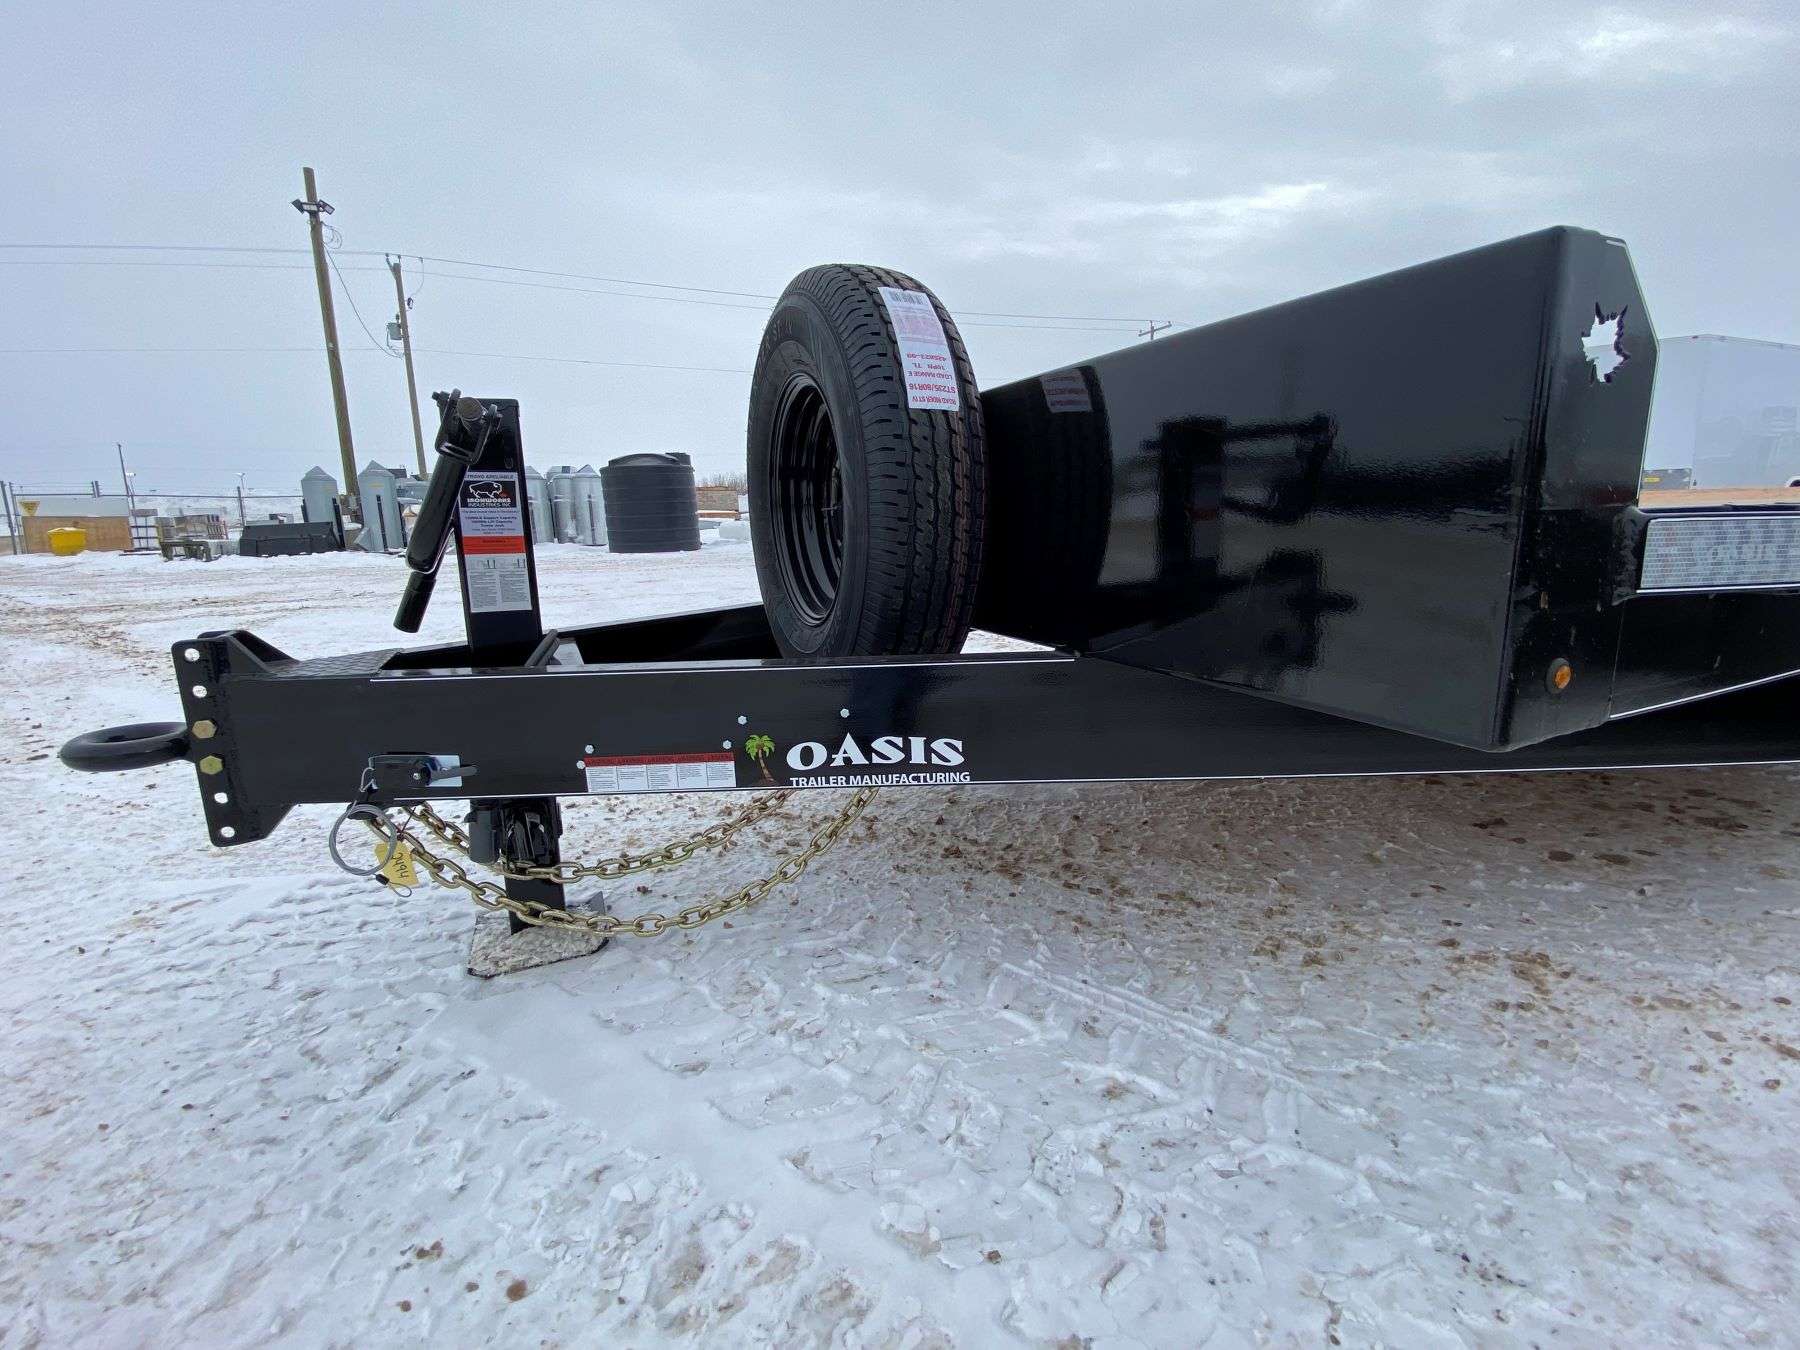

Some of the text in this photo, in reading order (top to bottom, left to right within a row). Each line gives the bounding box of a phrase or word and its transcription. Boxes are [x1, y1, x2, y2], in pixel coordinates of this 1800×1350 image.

[786, 732, 965, 771] OASIS
[790, 772, 971, 787] TRAILER MANUFACTURING
